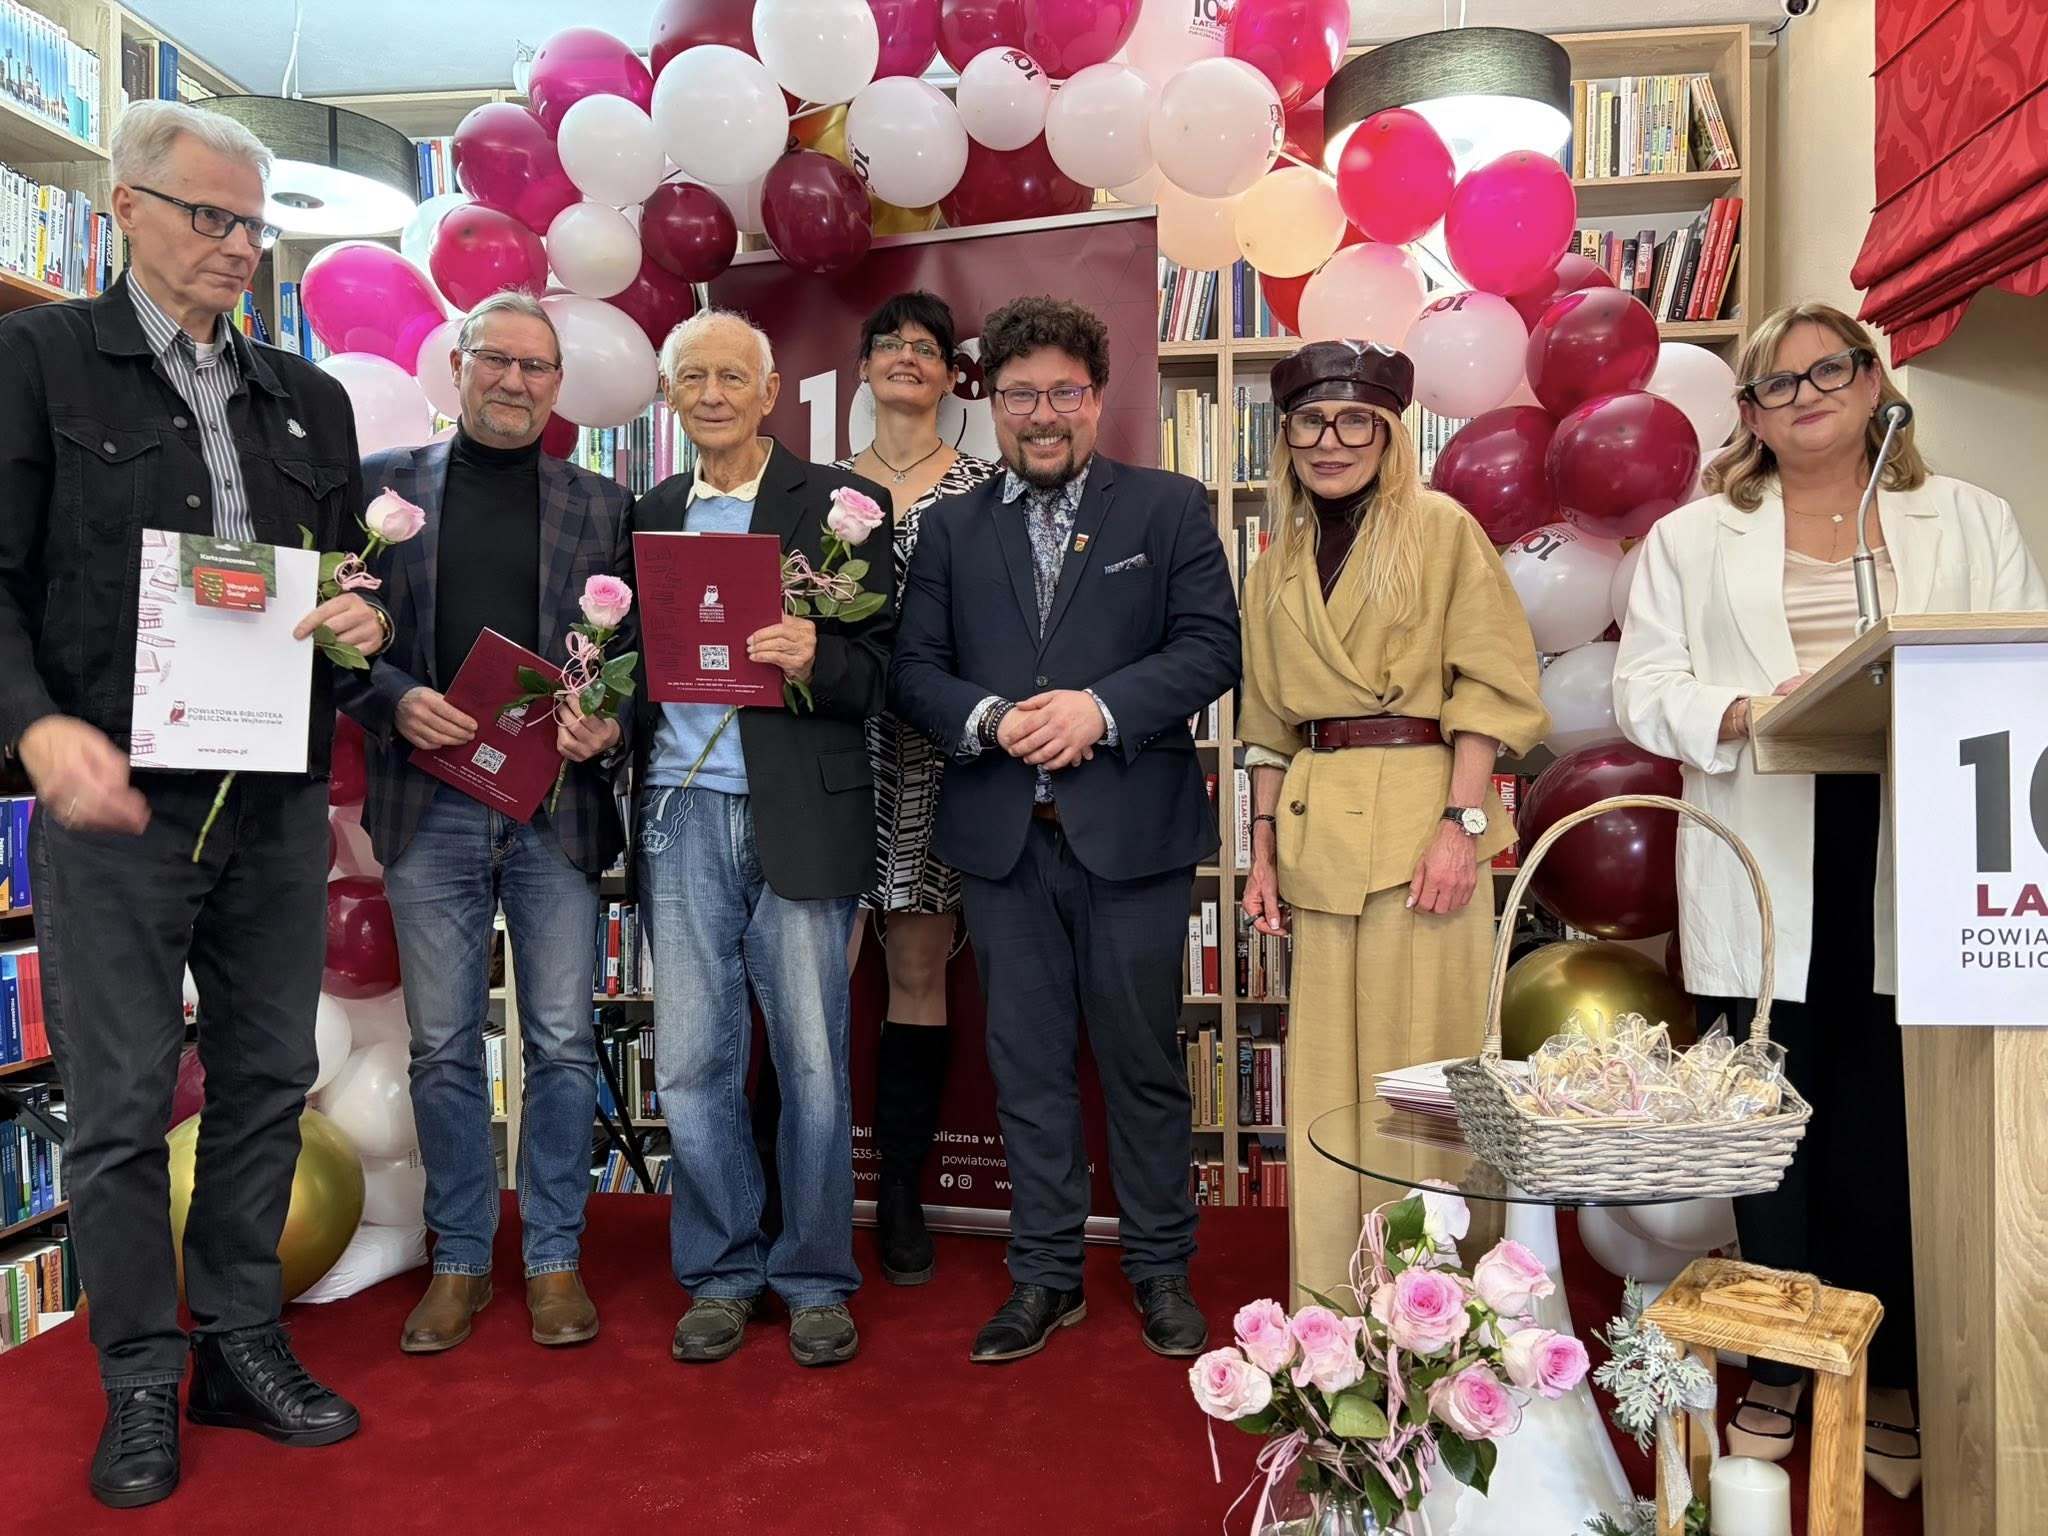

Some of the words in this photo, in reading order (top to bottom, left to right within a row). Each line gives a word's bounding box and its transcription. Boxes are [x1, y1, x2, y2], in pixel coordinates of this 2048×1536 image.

[188, 707, 238, 717] POWIATOWA
[239, 710, 284, 719] BIBLIOTEKA
[188, 714, 232, 723] PUBLICZNA
[1977, 883, 2048, 917] LA
[1962, 928, 2048, 946] POWIA
[1962, 951, 2048, 969] PUBLIC
[983, 1136, 995, 1144] w
[942, 1155, 1007, 1168] powiatowa
[50, 1253, 59, 1312] CHIRURG
